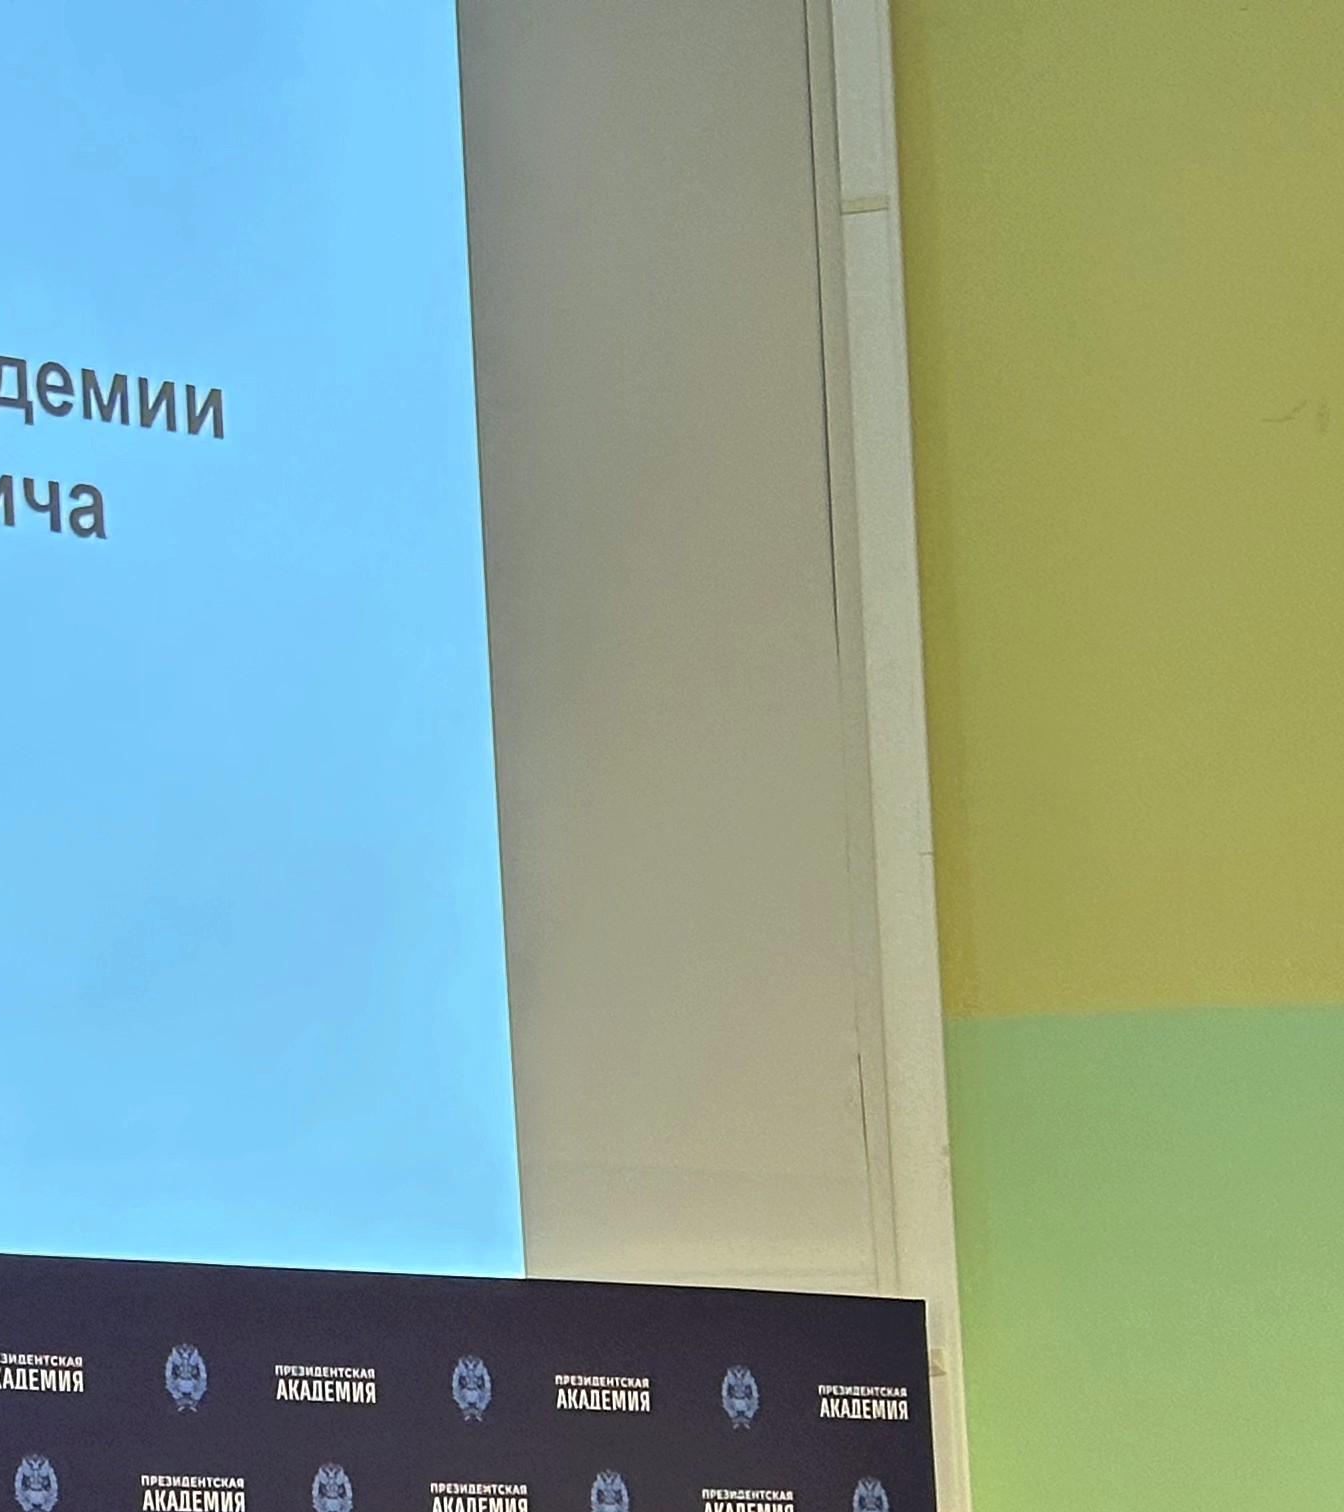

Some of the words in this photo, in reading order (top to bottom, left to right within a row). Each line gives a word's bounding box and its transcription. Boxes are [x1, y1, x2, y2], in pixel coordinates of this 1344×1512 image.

[275, 1365, 375, 1379] ПРЕЗИДЕНТСКАЯ
[555, 1375, 649, 1388] ПРЕЗИДЕНТСКАЯ
[277, 1379, 376, 1403] АКАДЕМИЯ
[819, 1385, 907, 1396] ПРЕЗИДЕНТСКАЯ
[557, 1389, 650, 1411] АКАДЕМИЯ
[820, 1398, 908, 1419] АКАДЕМИЯ
[141, 1475, 244, 1488] ПРЕЗИДЕНТСКАЯ
[431, 1483, 527, 1495] ПРЕЗИДЕНТСКАЯ
[702, 1489, 793, 1500] ПРЕЗИДЕНТСКАЯ
[143, 1490, 245, 1512] АКАДЕМИЯ
